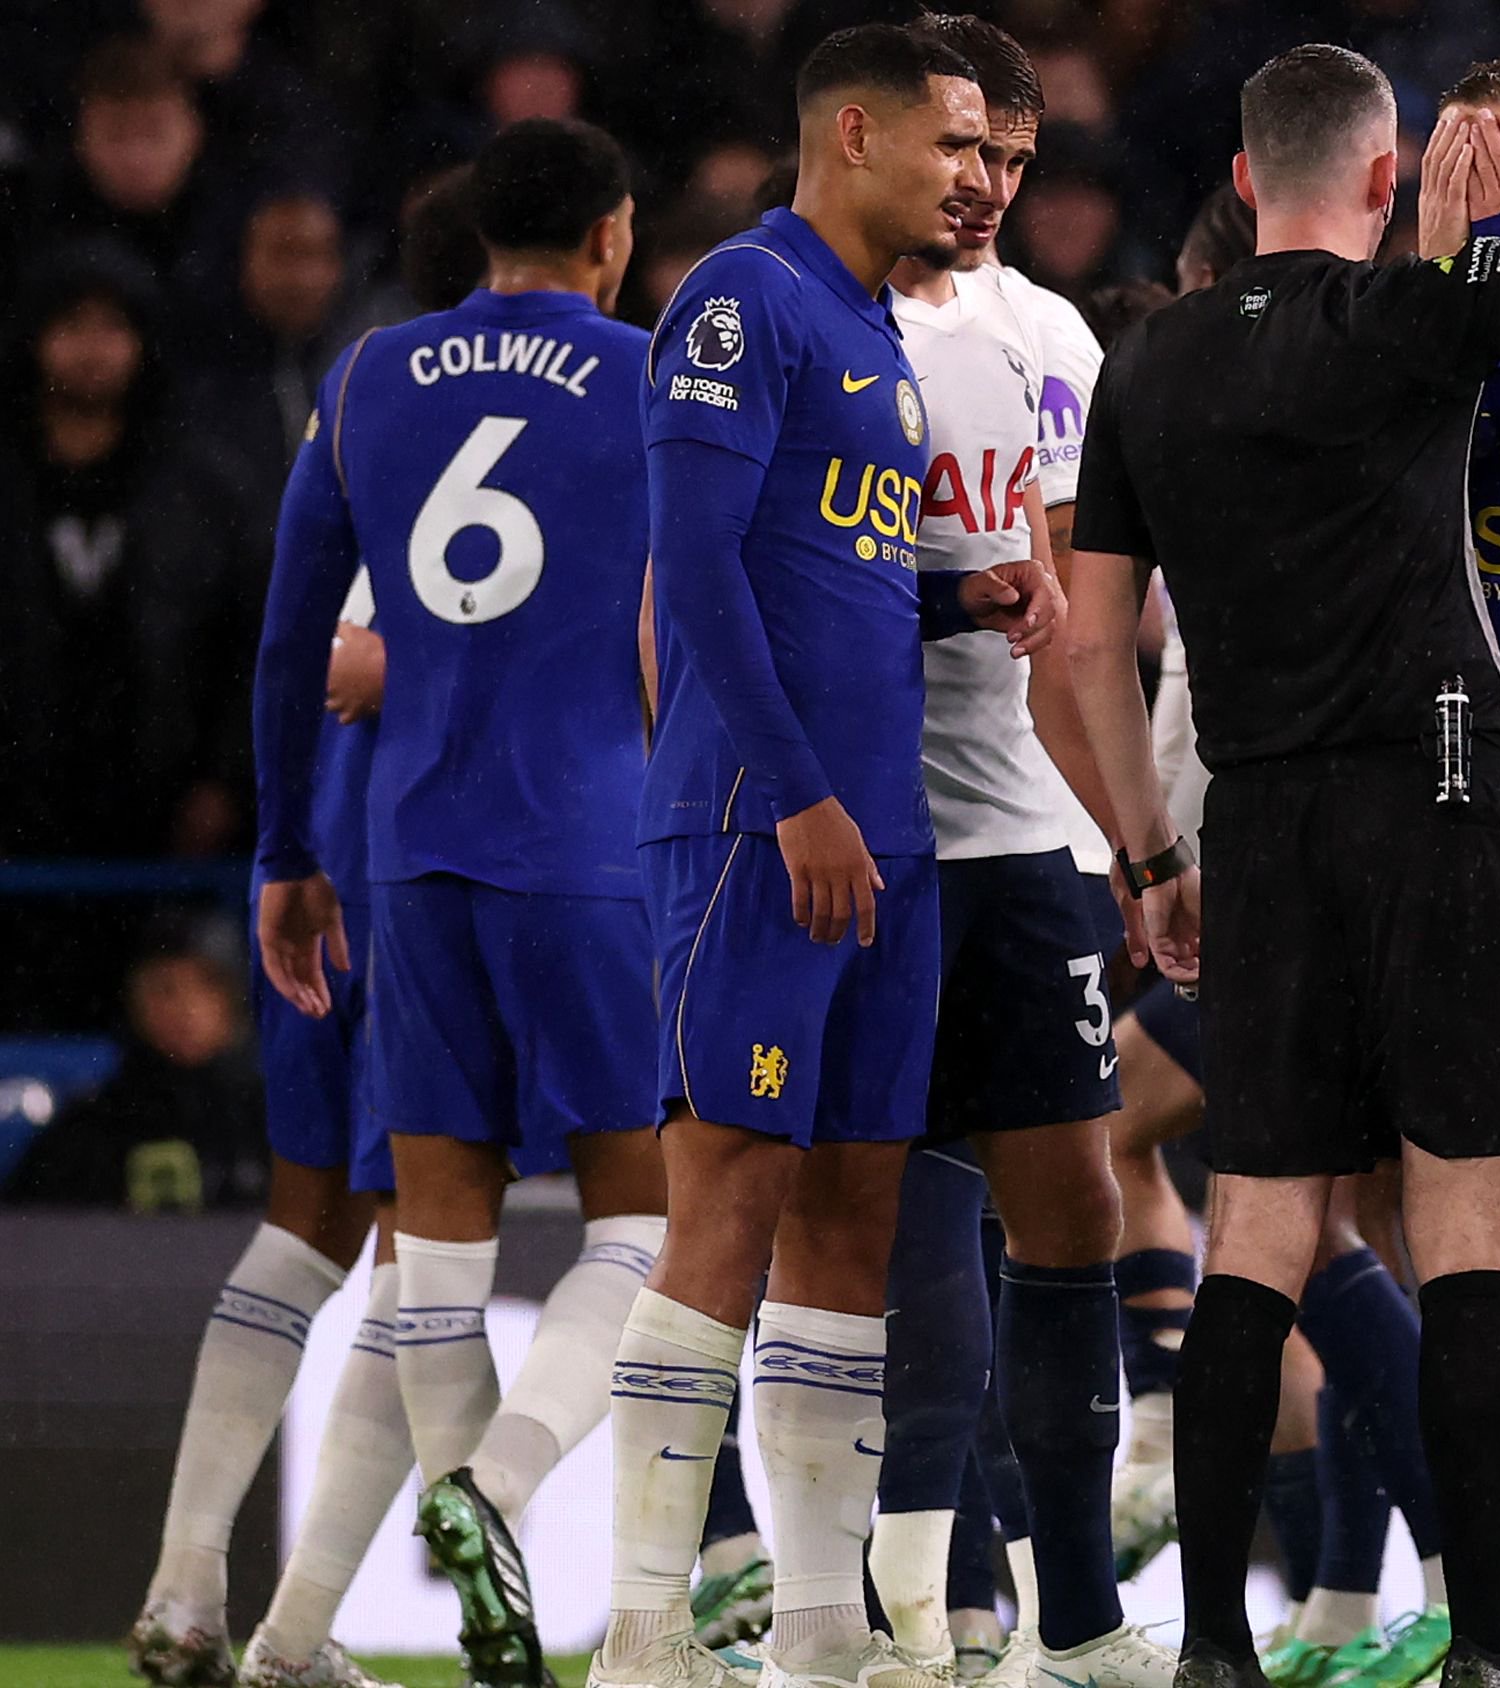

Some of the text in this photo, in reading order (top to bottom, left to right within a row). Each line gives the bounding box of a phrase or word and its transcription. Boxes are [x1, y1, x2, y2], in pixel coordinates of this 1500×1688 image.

[1246, 294, 1268, 303] PRO
[410, 332, 600, 398] COLWILL
[669, 385, 738, 411] for racism
[671, 374, 734, 398] No room
[820, 458, 921, 545] USD
[409, 415, 544, 625] 6
[882, 543, 898, 563] BY
